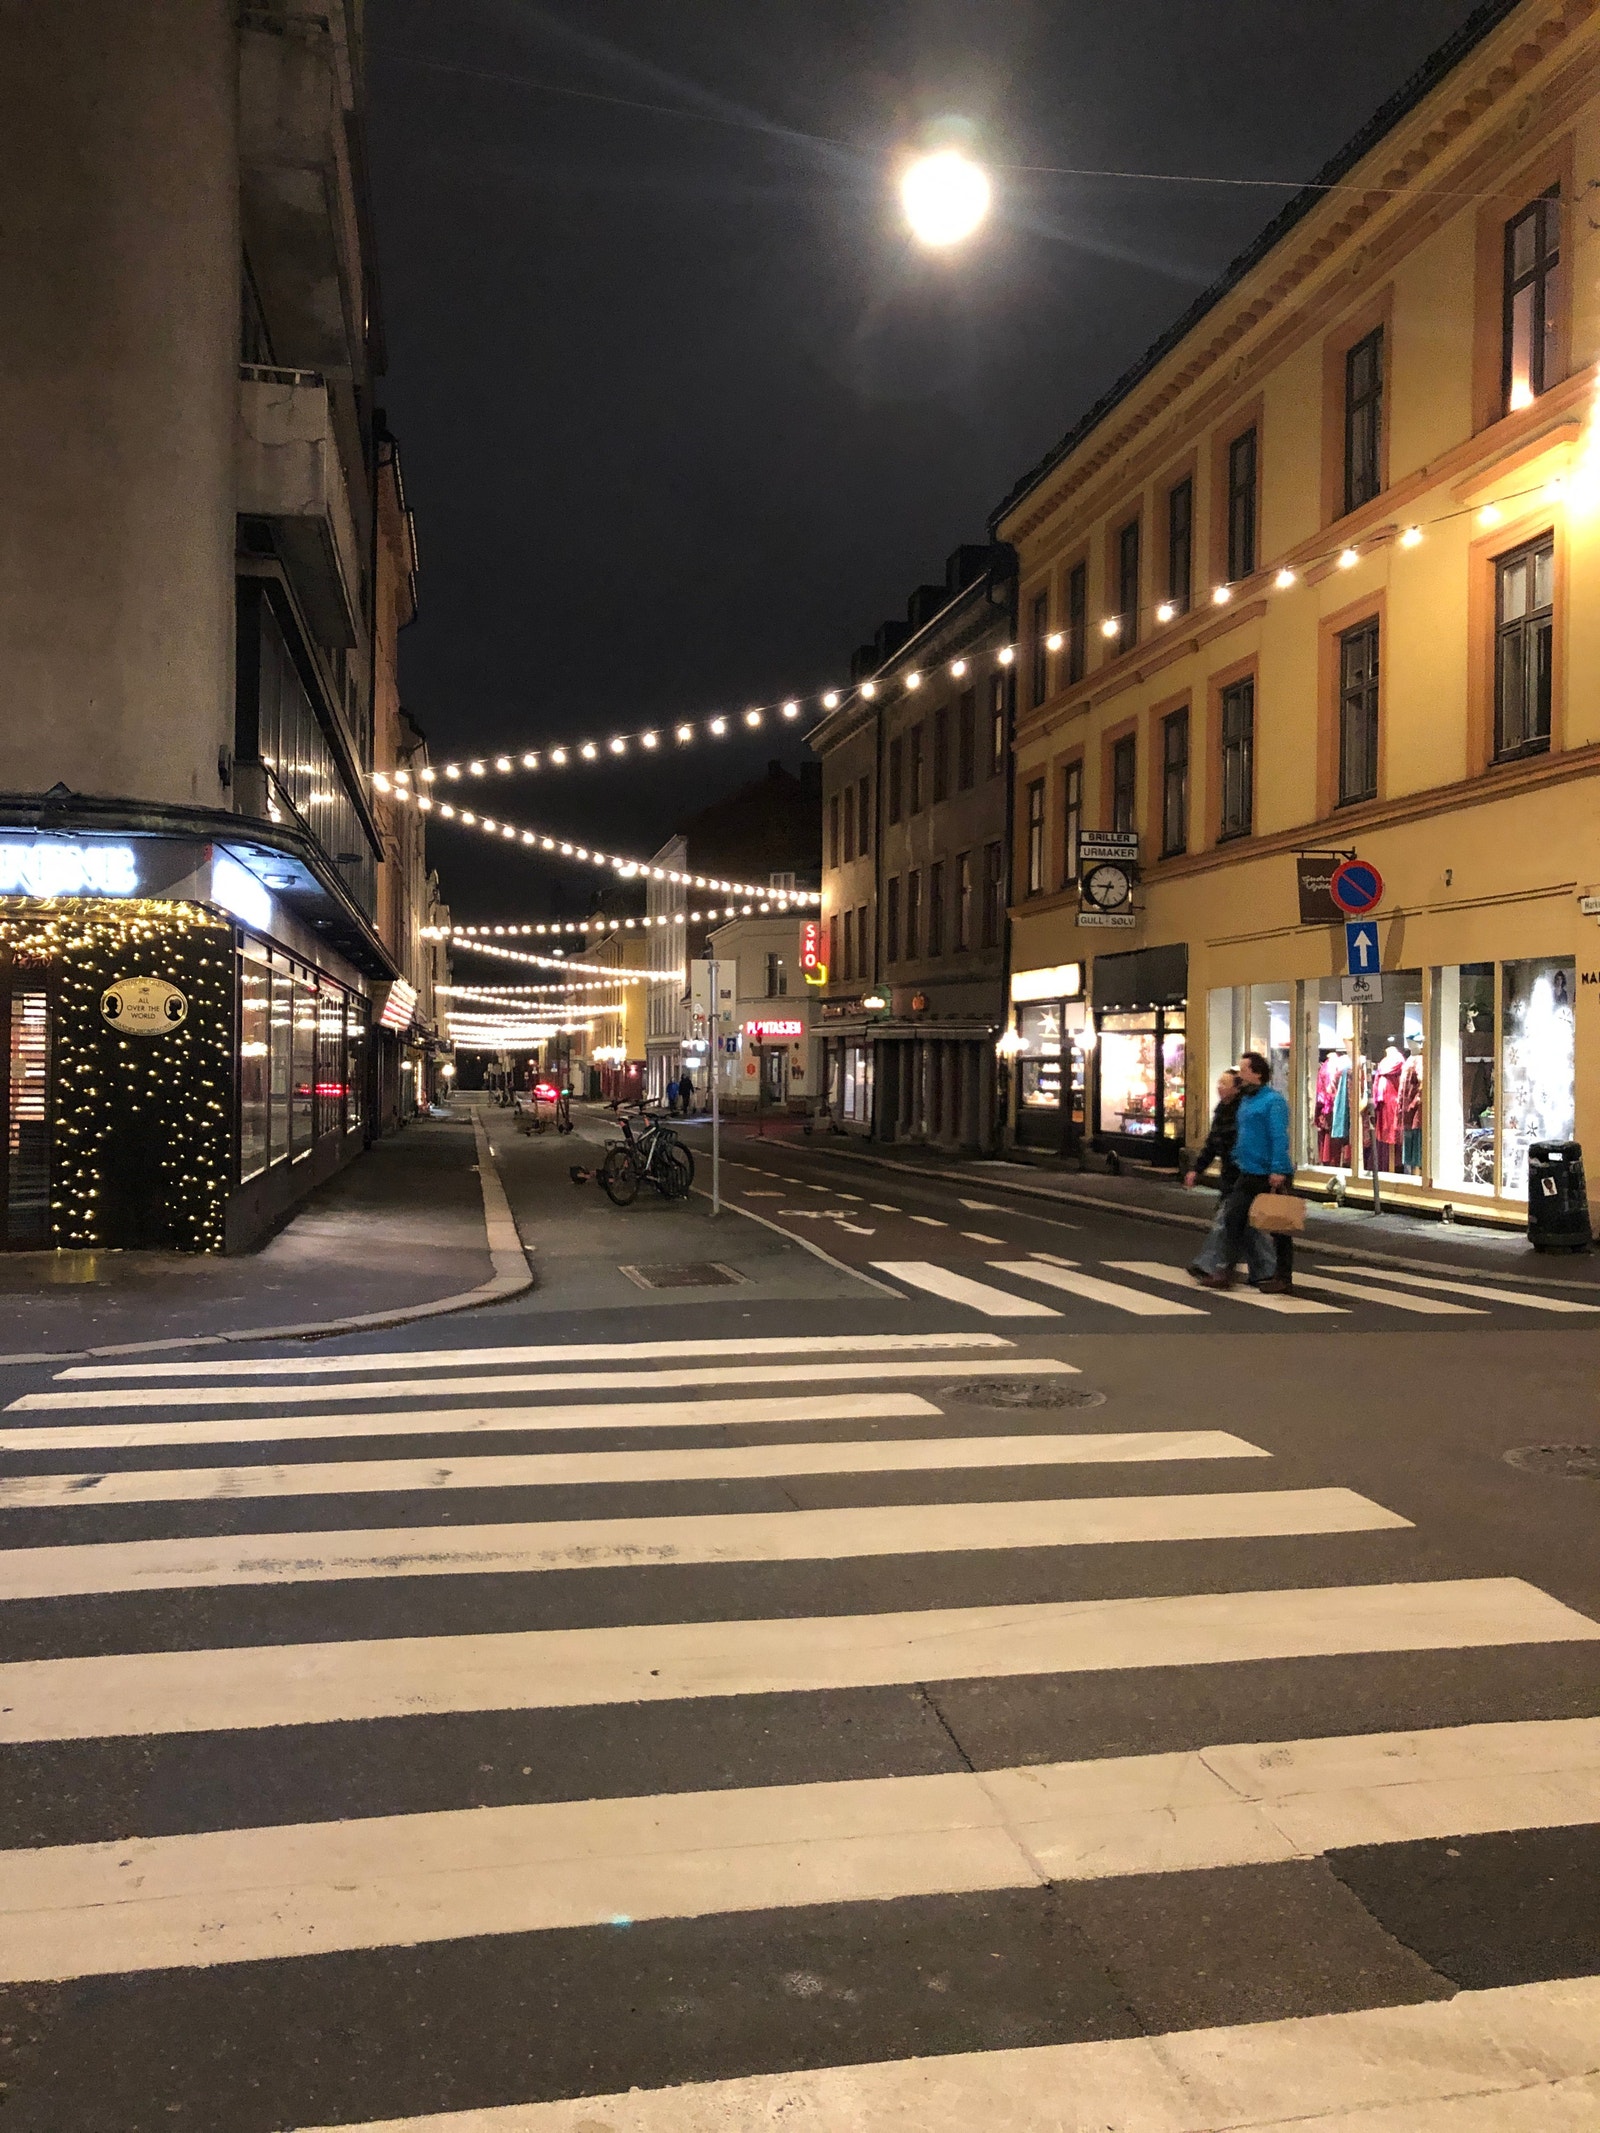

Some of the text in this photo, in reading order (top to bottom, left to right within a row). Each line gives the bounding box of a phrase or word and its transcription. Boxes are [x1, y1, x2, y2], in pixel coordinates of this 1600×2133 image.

[1088, 832, 1130, 842] BRILLER
[1083, 847, 1135, 857] URMAKER
[1080, 916, 1104, 925] GULL
[805, 924, 816, 967] SKO
[1581, 971, 1600, 985] MA
[1350, 993, 1374, 1002] unntatt
[127, 1004, 145, 1012] OVER
